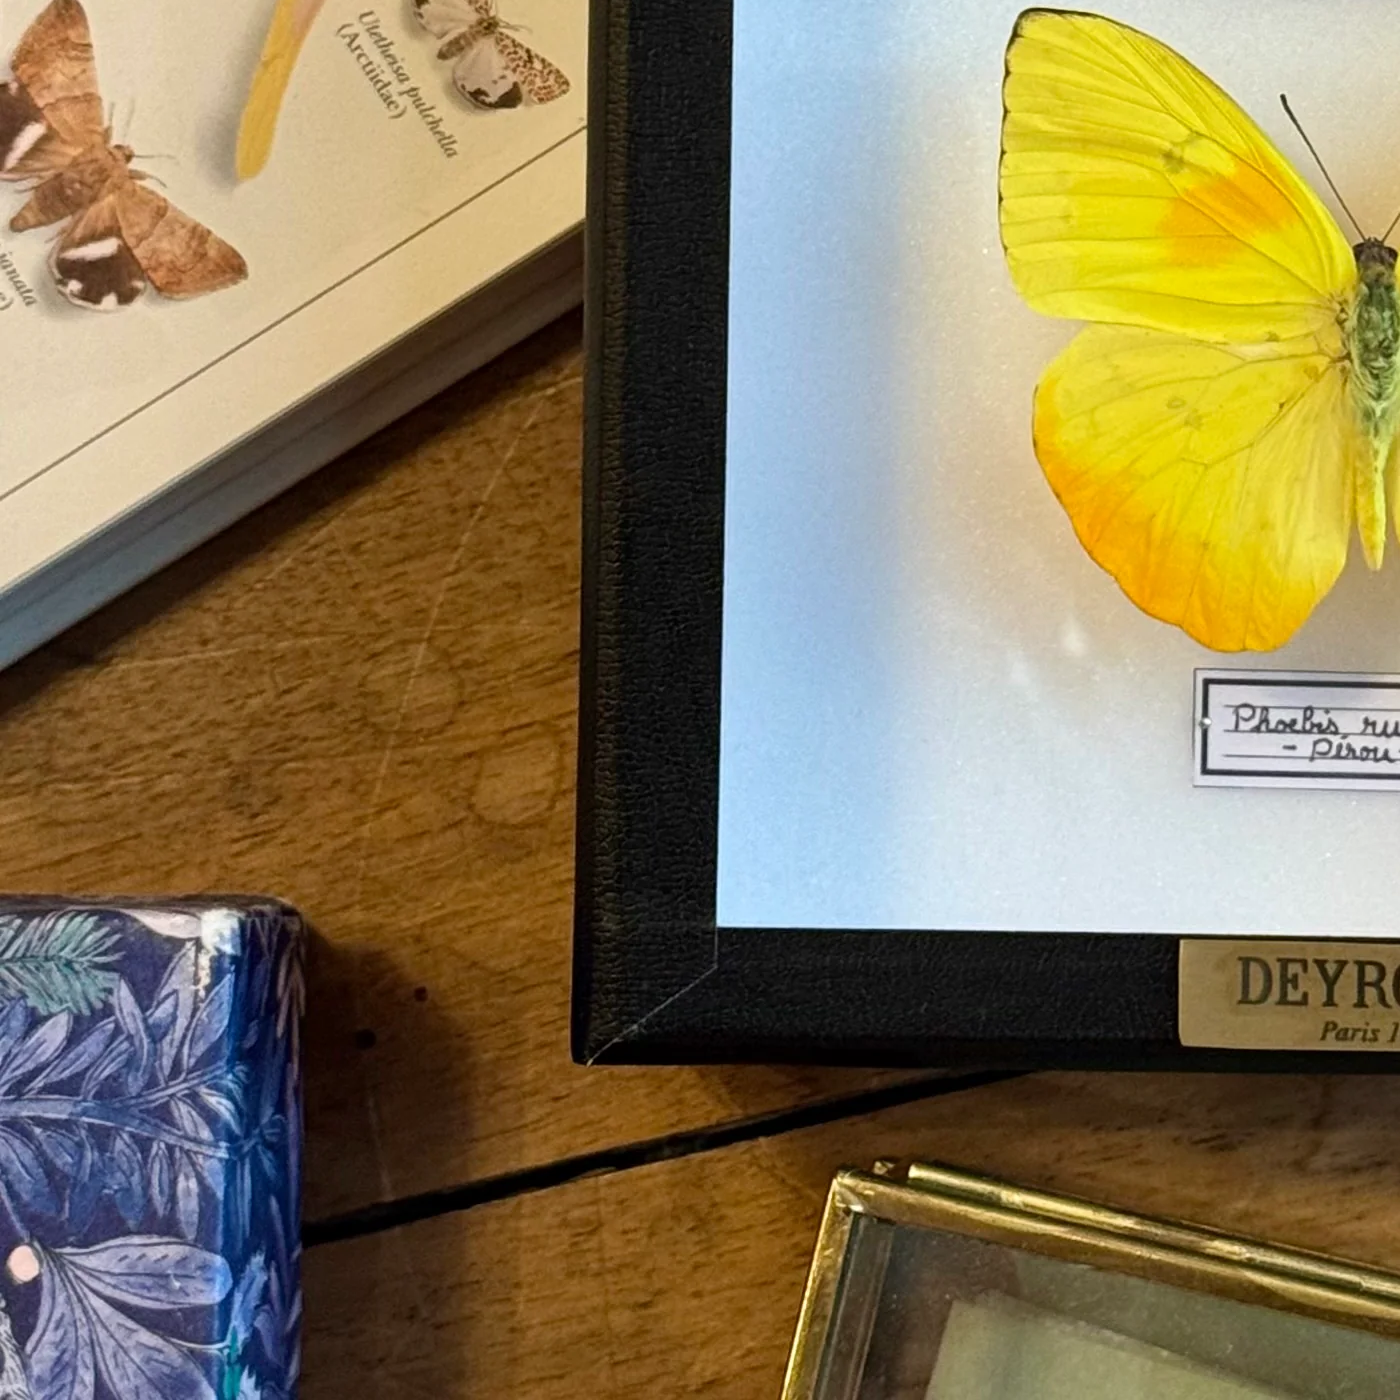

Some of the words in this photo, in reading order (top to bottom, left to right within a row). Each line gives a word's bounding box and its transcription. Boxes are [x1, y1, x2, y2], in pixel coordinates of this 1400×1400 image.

[335, 23, 407, 120] (Arctiidae)
[358, 10, 411, 85] Utetheisa
[397, 86, 458, 159] pulchella
[1233, 702, 1340, 735] Phoebis
[1319, 1020, 1380, 1044] Paris
